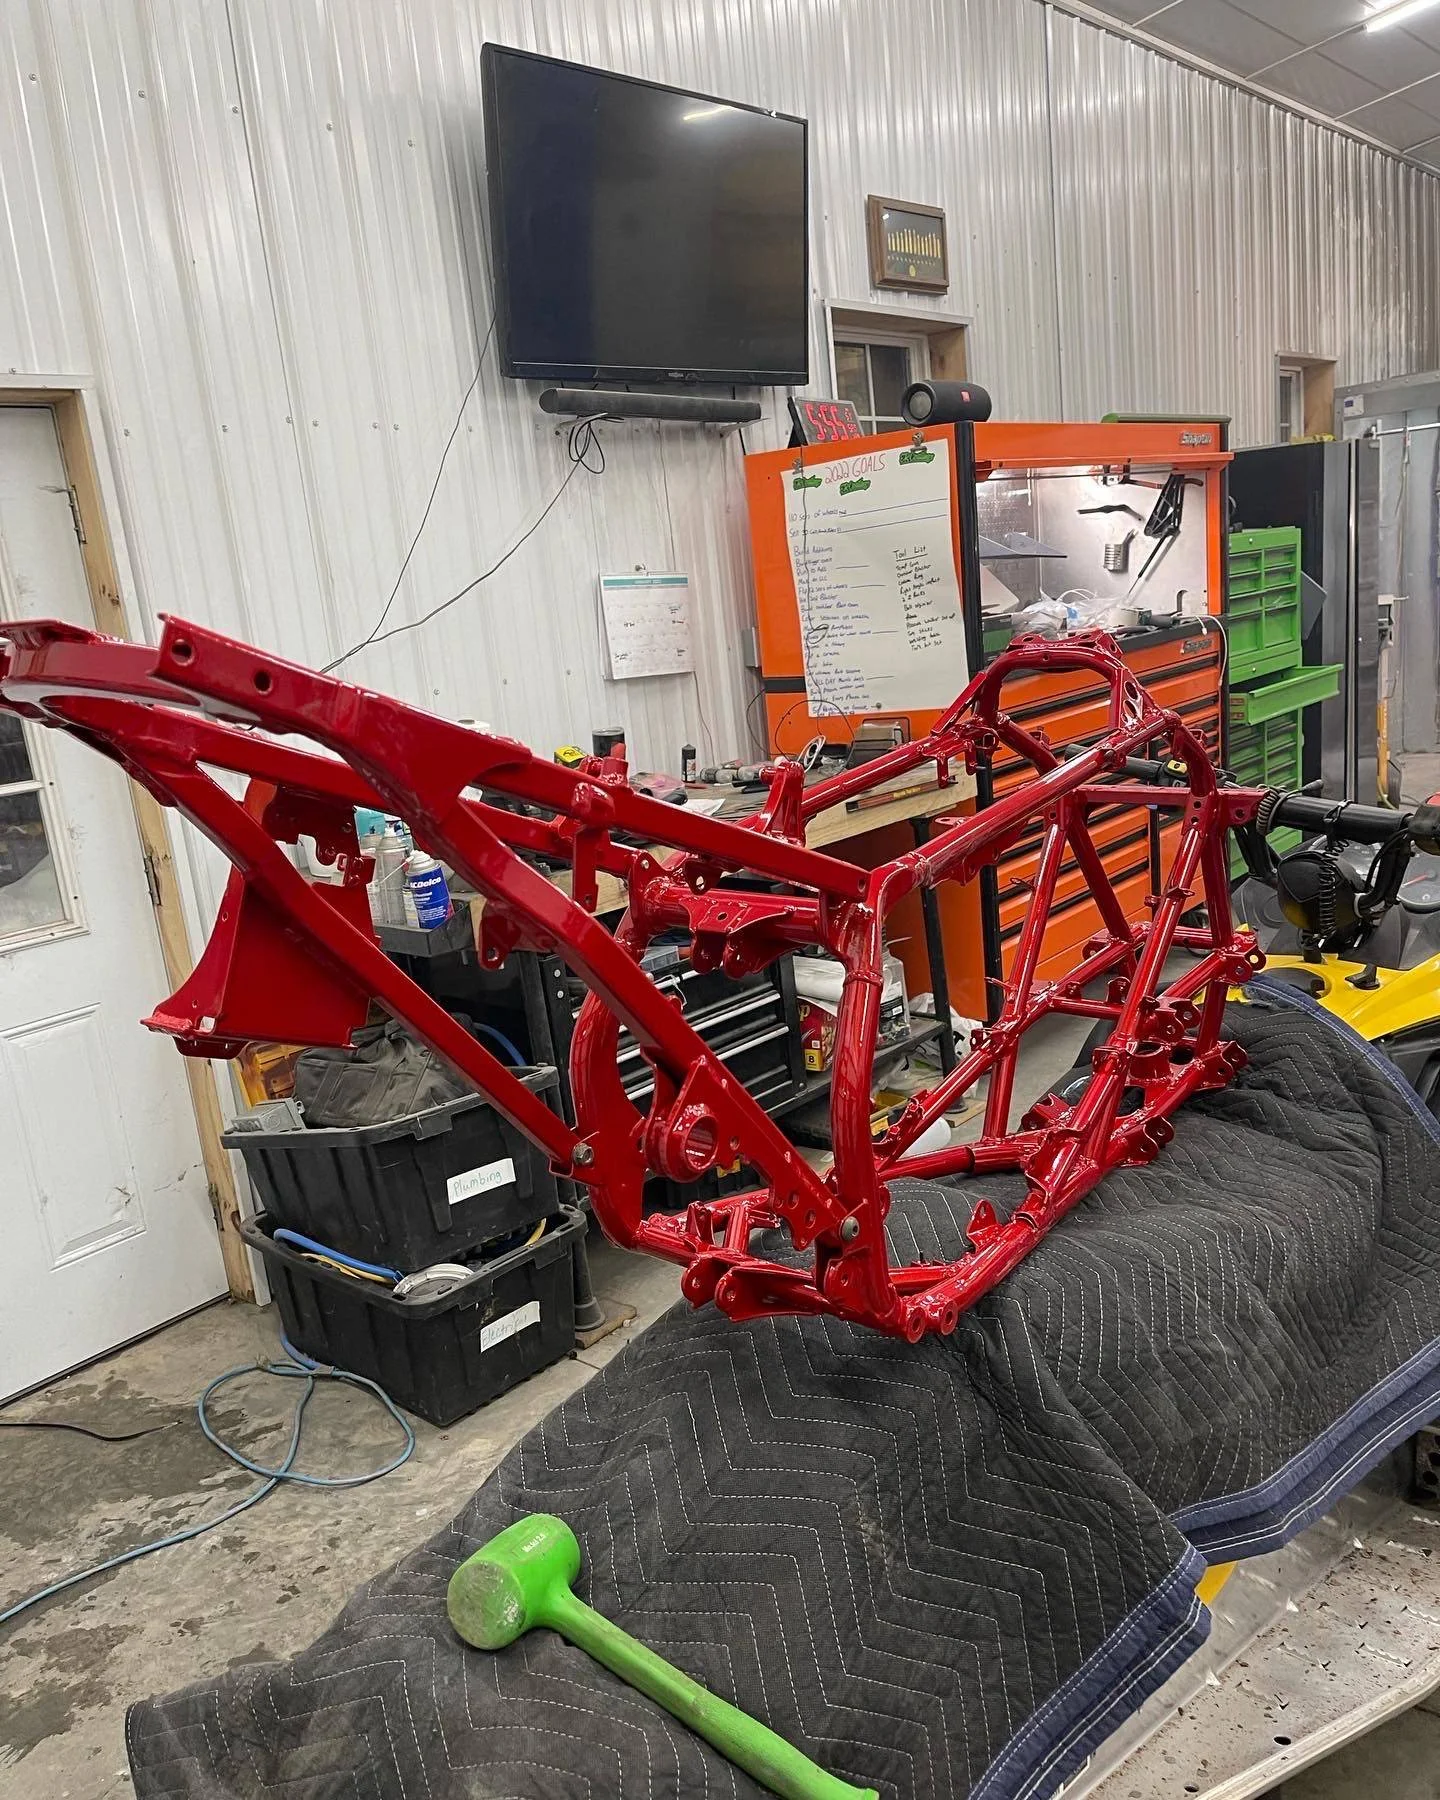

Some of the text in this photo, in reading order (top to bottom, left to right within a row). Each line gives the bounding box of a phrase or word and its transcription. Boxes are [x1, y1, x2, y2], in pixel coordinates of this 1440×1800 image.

[824, 460, 849, 484] 2022
[852, 453, 886, 477] GOALS
[453, 1171, 502, 1198] Plumbing
